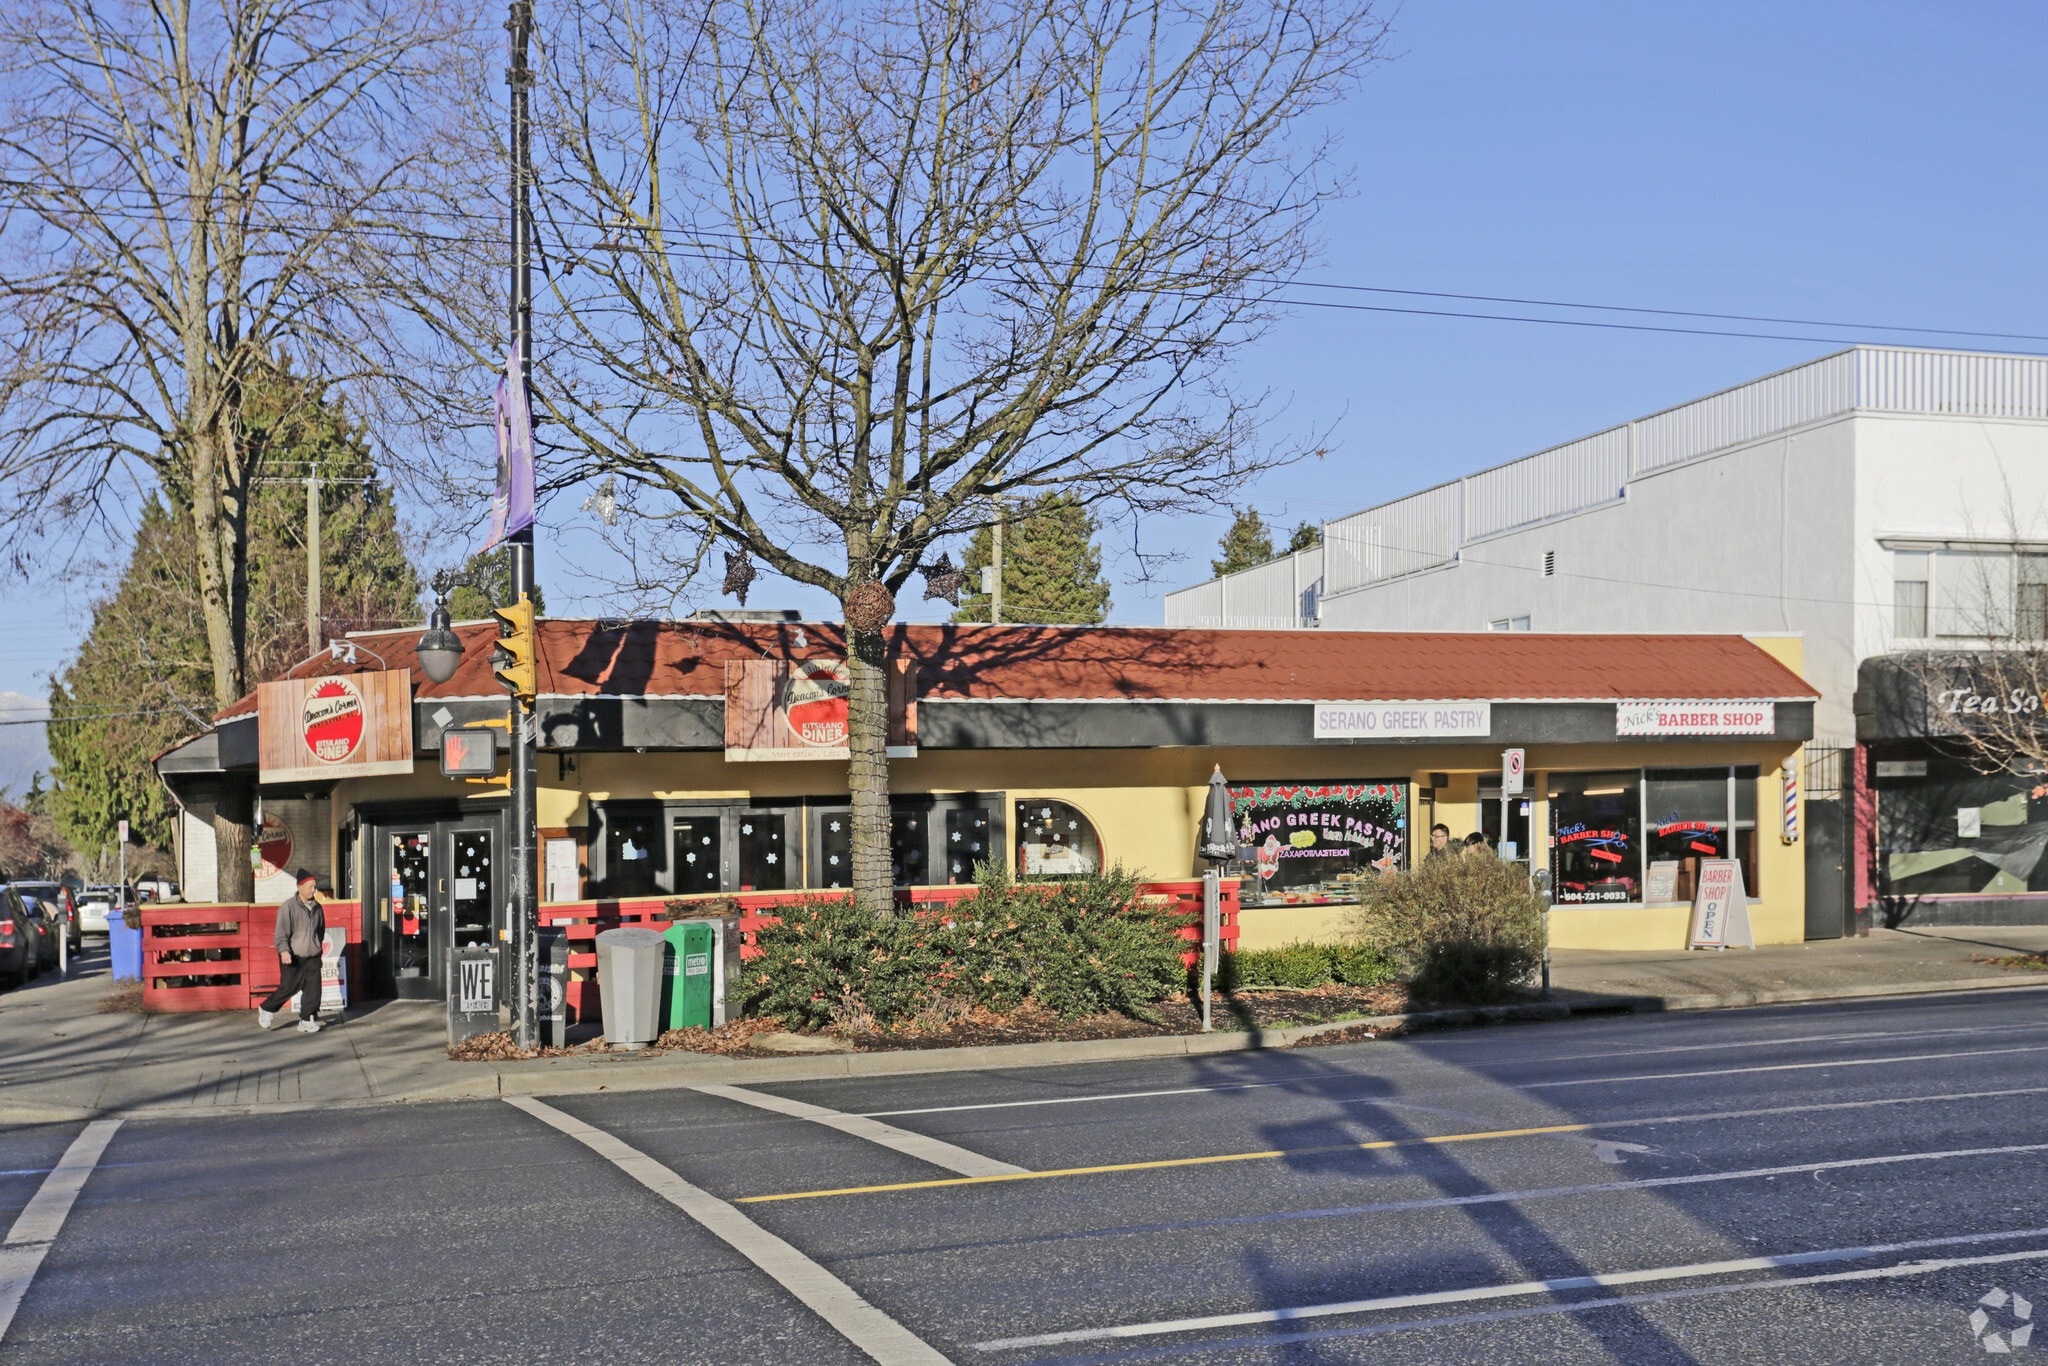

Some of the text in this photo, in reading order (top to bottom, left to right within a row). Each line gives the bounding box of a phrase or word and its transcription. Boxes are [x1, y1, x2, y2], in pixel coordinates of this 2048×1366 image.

[788, 689, 824, 704] Deacon's
[1938, 687, 1999, 713] Tea
[305, 699, 357, 723] Deacon's Corner
[1624, 708, 1763, 729] Nick's BARBER SHOP
[802, 722, 844, 730] KITSILANO
[1319, 710, 1484, 730] SERANO GREEK PASTRY
[802, 728, 843, 742] DINER
[315, 738, 350, 748] KITSILANO
[316, 744, 350, 760] DINER
[771, 750, 791, 758] More
[1286, 813, 1341, 827] GREEK
[1346, 817, 1404, 848] PASTRY
[1557, 823, 1586, 836] Nick's
[1560, 830, 1598, 844] BARBER
[1601, 829, 1627, 841] SHOP
[1658, 821, 1693, 837] BARBER
[1702, 870, 1733, 883] BARBER
[1704, 886, 1726, 900] SHOP
[687, 955, 706, 968] metro
